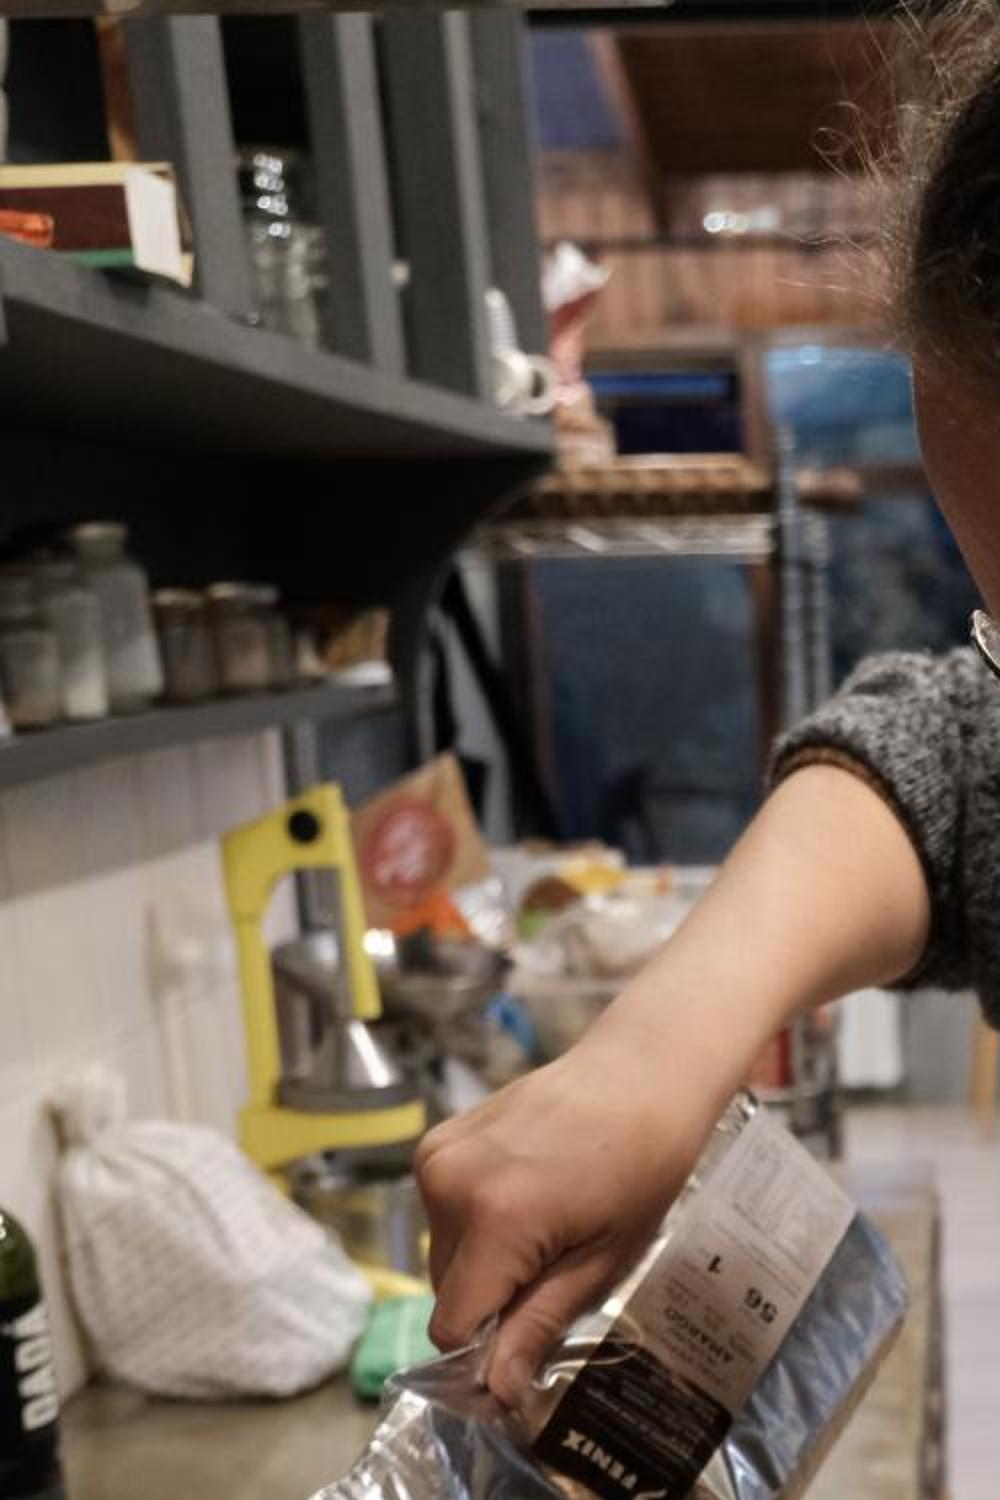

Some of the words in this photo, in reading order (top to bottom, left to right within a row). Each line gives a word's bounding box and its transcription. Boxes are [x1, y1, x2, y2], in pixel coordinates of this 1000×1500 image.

[744, 1286, 778, 1324] 56
[664, 1306, 735, 1363] AMARGO
[561, 1428, 638, 1490] FENIX
